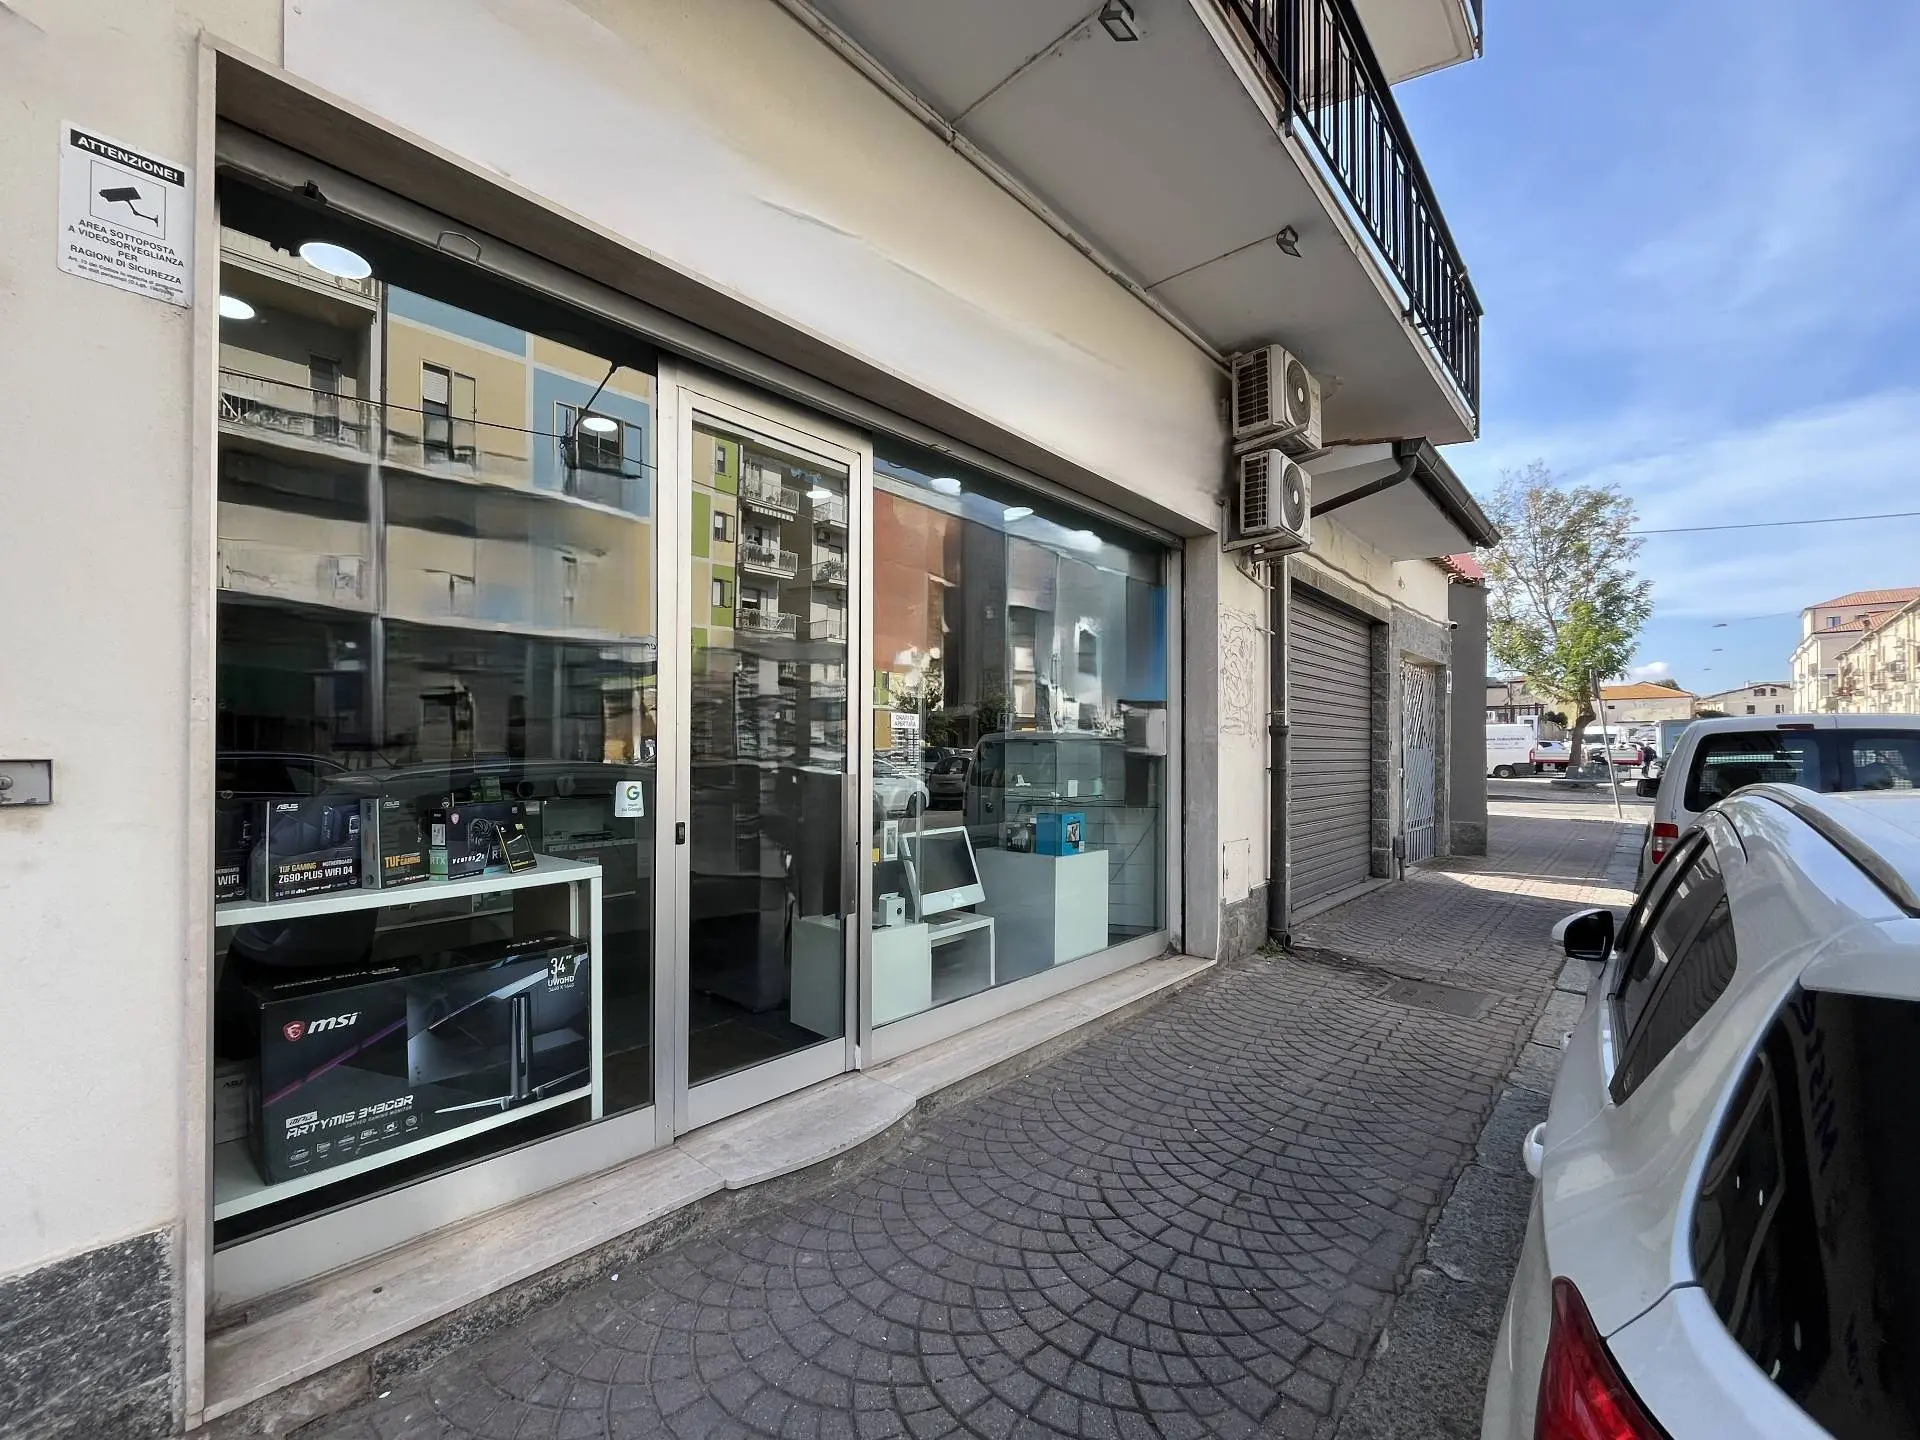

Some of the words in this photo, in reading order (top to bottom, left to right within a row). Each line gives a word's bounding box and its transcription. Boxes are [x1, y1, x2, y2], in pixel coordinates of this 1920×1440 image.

[77, 136, 179, 182] ATTENZIONE!
[78, 219, 107, 235] AREA
[110, 229, 175, 256] SOTTOPOSTA
[68, 225, 76, 233] A
[78, 229, 185, 268] VIDEOSORVEGLIANZA
[118, 250, 138, 262] PER
[70, 244, 113, 264] RAGIONI
[115, 259, 126, 268] DI
[128, 262, 182, 285] SICUREZZA
[276, 803, 299, 811] ASUS
[279, 862, 291, 874] TUF
[291, 862, 317, 872] GAMING
[384, 855, 400, 868] TUF
[217, 874, 240, 886] WIFI
[278, 869, 323, 884] Z690-PLUS
[324, 867, 341, 878] WIFI
[343, 865, 353, 875] D4
[547, 975, 575, 987] UWQHD
[307, 1012, 359, 1035] msi
